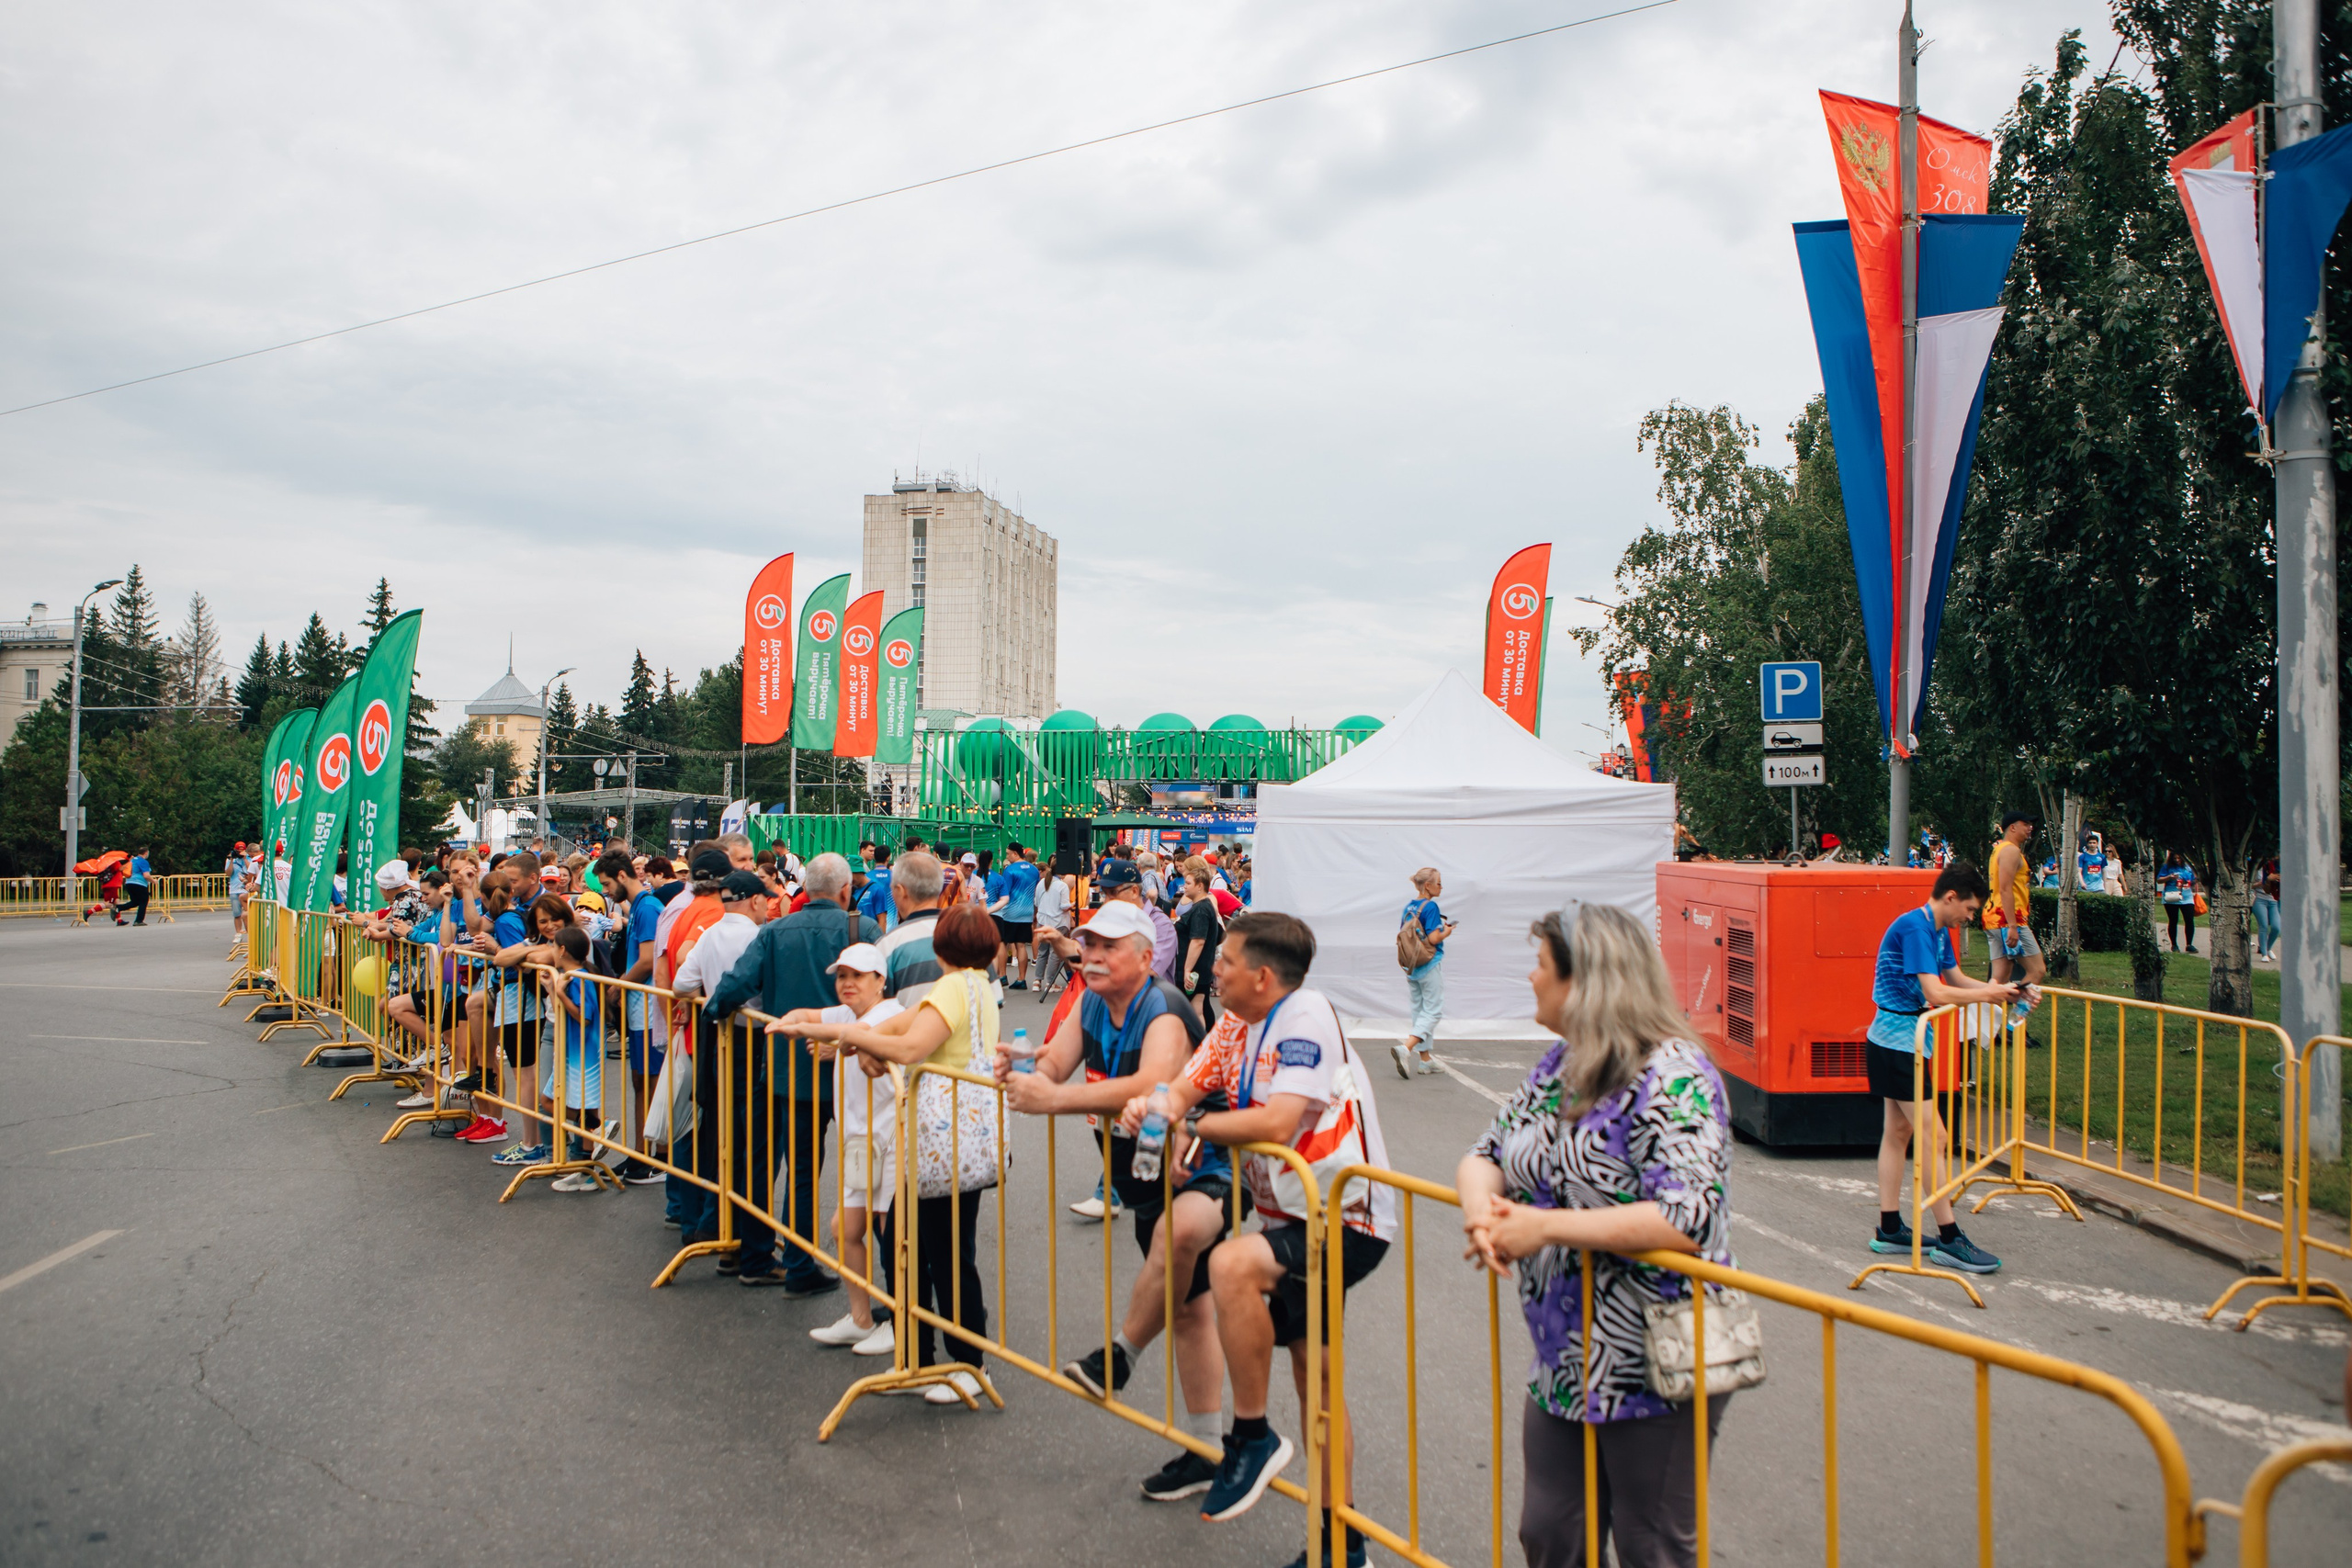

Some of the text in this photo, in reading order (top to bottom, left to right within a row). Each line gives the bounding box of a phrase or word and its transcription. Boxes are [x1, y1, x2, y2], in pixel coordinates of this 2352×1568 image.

[1927, 147, 1984, 185] Омск
[1920, 183, 1977, 214] 308
[757, 639, 769, 716] от 30 минут
[770, 638, 782, 700] Доставка
[808, 651, 820, 720] выручает!
[817, 651, 831, 720] Пятёрочка
[859, 664, 869, 719] Доставка
[1497, 630, 1514, 713] от 30 минут
[1513, 629, 1531, 696] Доставка
[1775, 669, 1808, 715] P
[846, 664, 858, 732] от 30 минут
[886, 676, 897, 737] выручает!
[896, 677, 908, 738] Пятёрочка
[356, 839, 365, 869] 30
